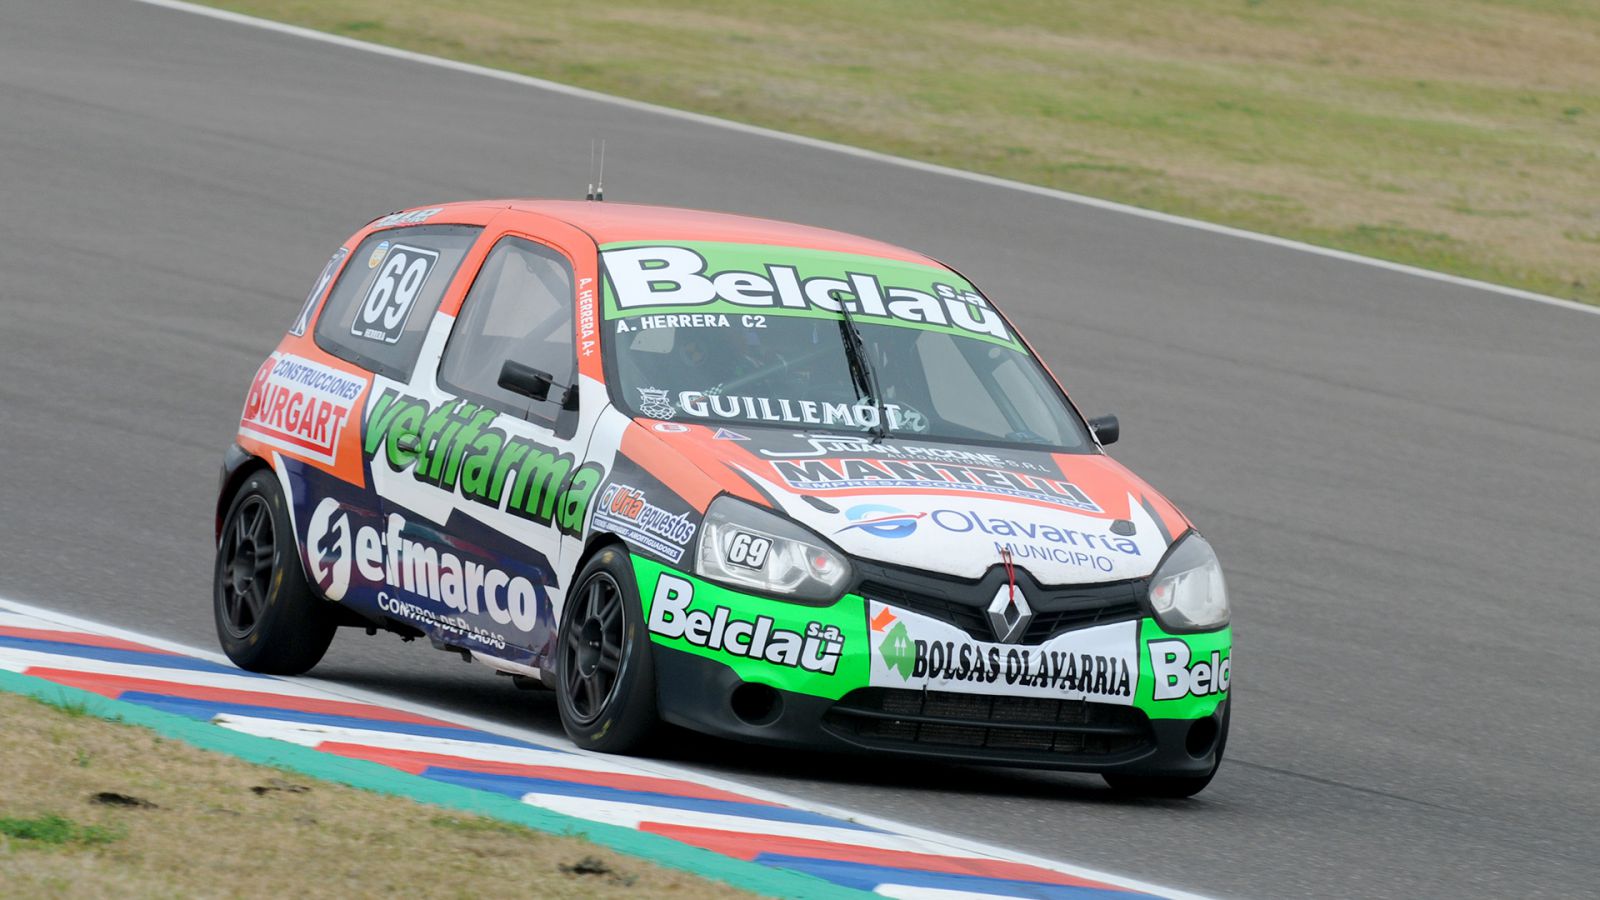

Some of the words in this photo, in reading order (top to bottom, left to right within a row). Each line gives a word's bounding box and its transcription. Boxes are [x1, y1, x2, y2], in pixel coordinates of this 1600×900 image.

[363, 252, 428, 330] 69
[580, 290, 594, 339] HERRERA
[616, 319, 637, 334] A.
[641, 314, 730, 330] HERRERA
[741, 315, 767, 328] C2
[582, 340, 595, 357] A+
[272, 359, 362, 400] CONSTRUCCIONES
[243, 357, 348, 452] BURGART
[678, 390, 901, 431] GUILLEMOT
[363, 387, 603, 541] vetifarma
[826, 442, 901, 455] JUAN
[902, 445, 1001, 464] PICONE
[771, 459, 1097, 504] MANTELLI
[800, 480, 909, 489] EMPRESA
[729, 533, 770, 568] 69
[993, 541, 1114, 573] MUNICIPIO
[355, 511, 537, 632] efmarco
[377, 591, 437, 627] CONTROL
[912, 639, 998, 684] BOLSAS
[1004, 648, 1131, 697] OLAVARRIA
[1148, 639, 1232, 700] Belc
